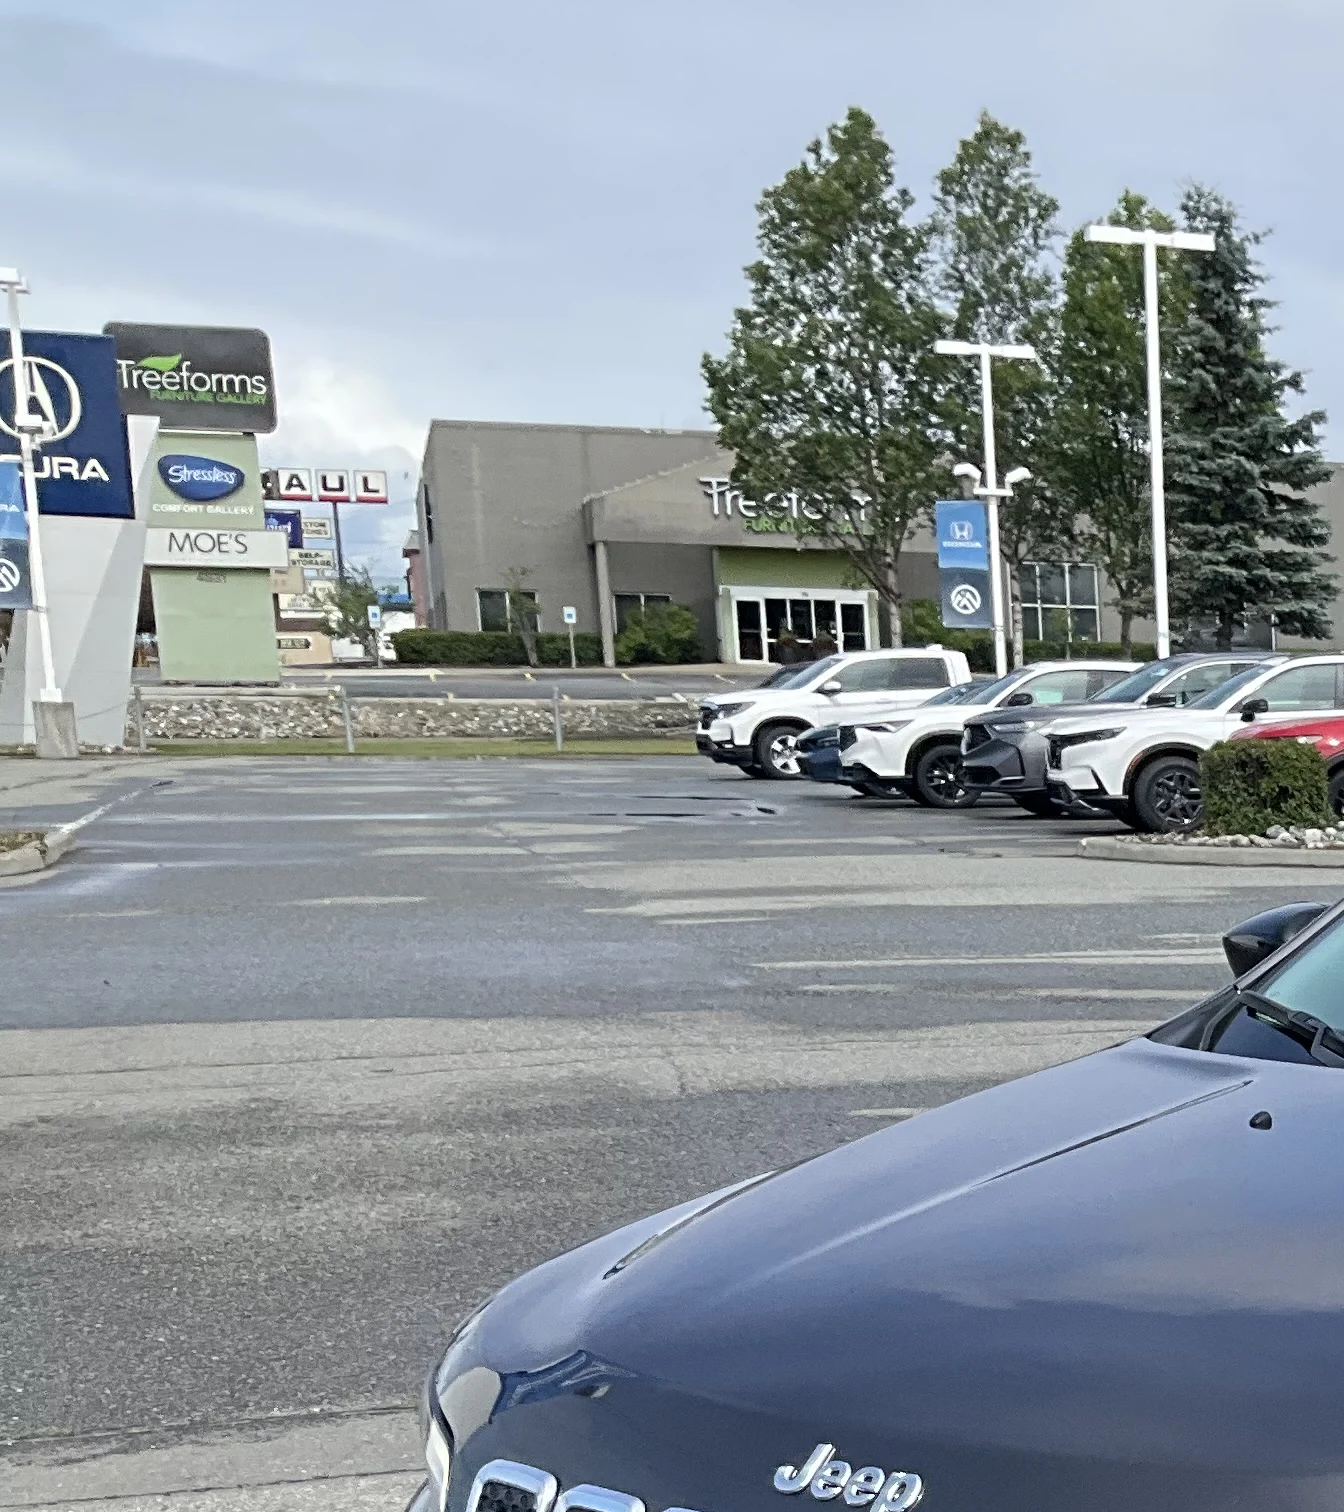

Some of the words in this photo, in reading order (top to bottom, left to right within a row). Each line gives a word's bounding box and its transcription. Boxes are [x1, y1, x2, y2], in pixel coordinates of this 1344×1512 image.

[116, 357, 267, 395] Treeforms
[168, 463, 238, 485] Stressless
[278, 472, 380, 494] AUL
[168, 531, 248, 554] MOE'S
